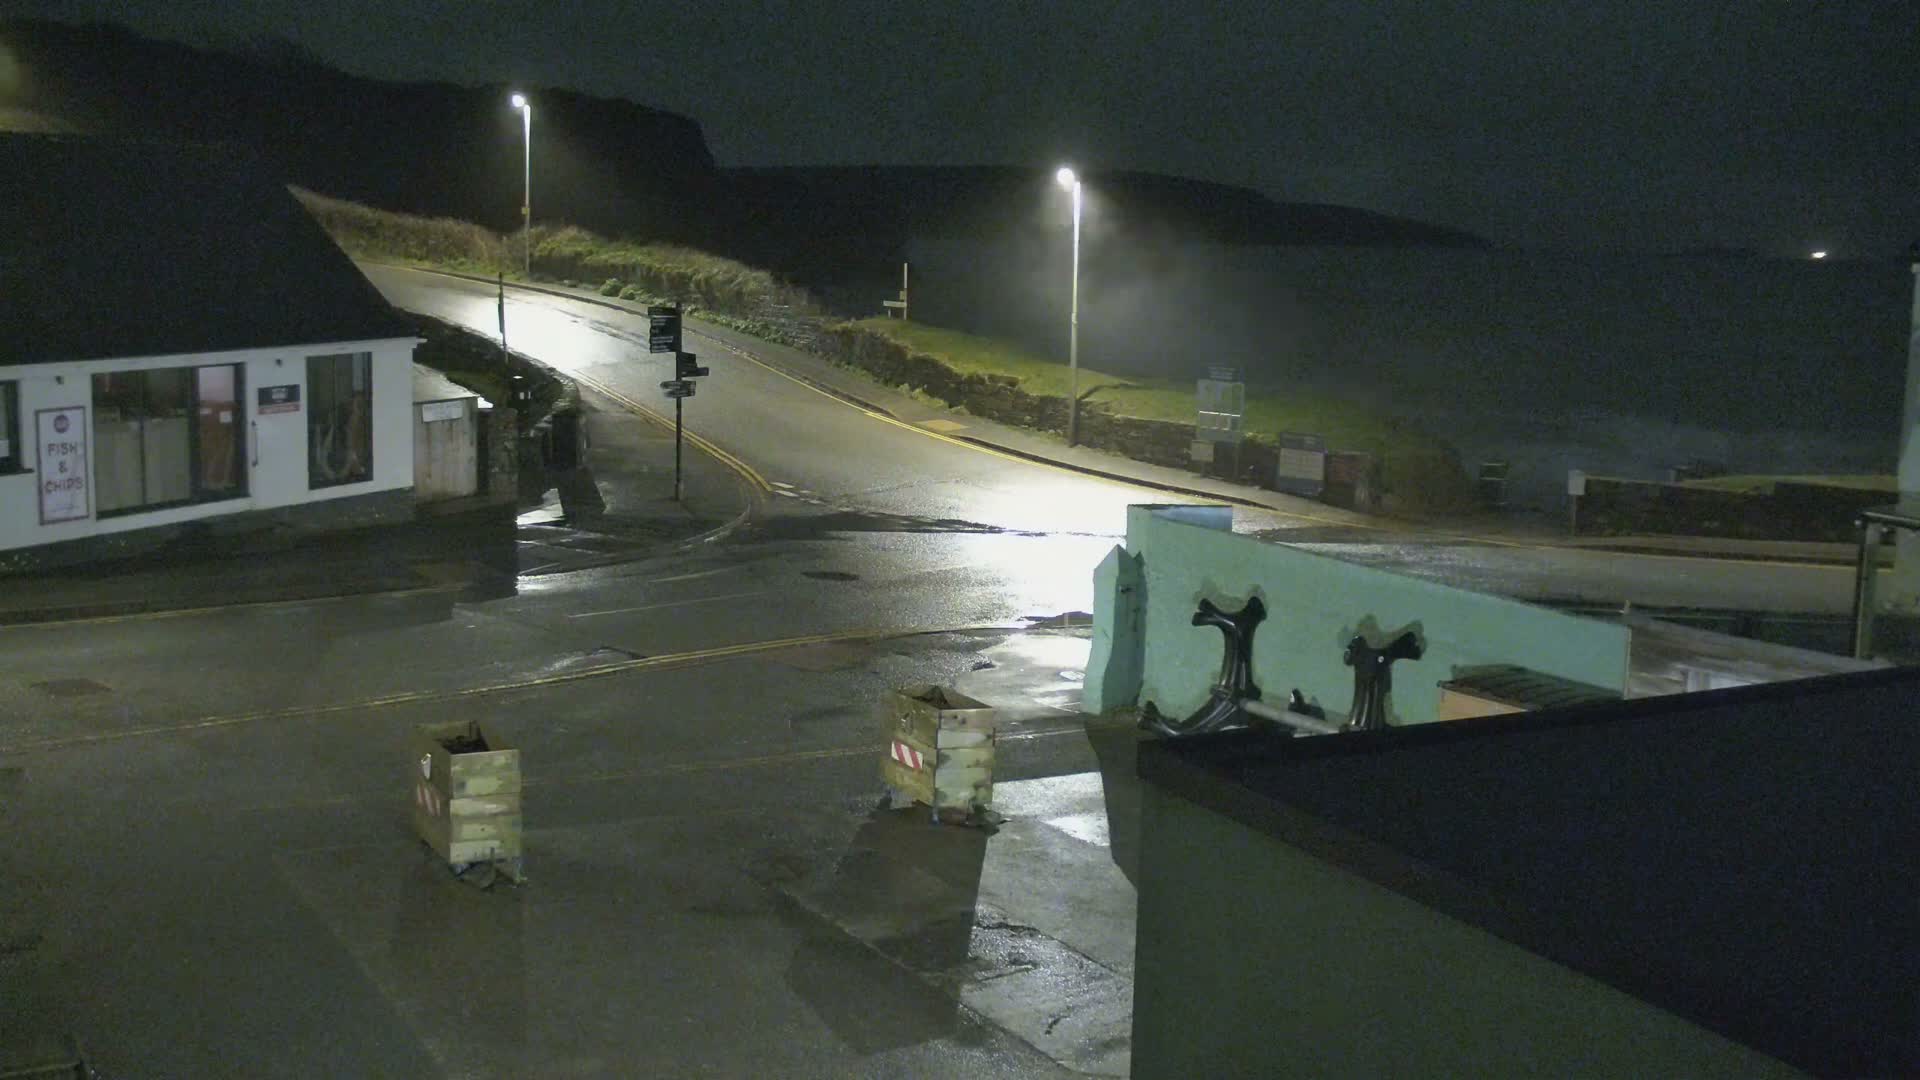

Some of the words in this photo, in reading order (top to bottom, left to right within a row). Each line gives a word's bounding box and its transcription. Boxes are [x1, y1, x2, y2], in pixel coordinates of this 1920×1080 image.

[47, 442, 78, 456] FISH
[58, 461, 68, 473] &
[45, 477, 84, 494] CHIPS
